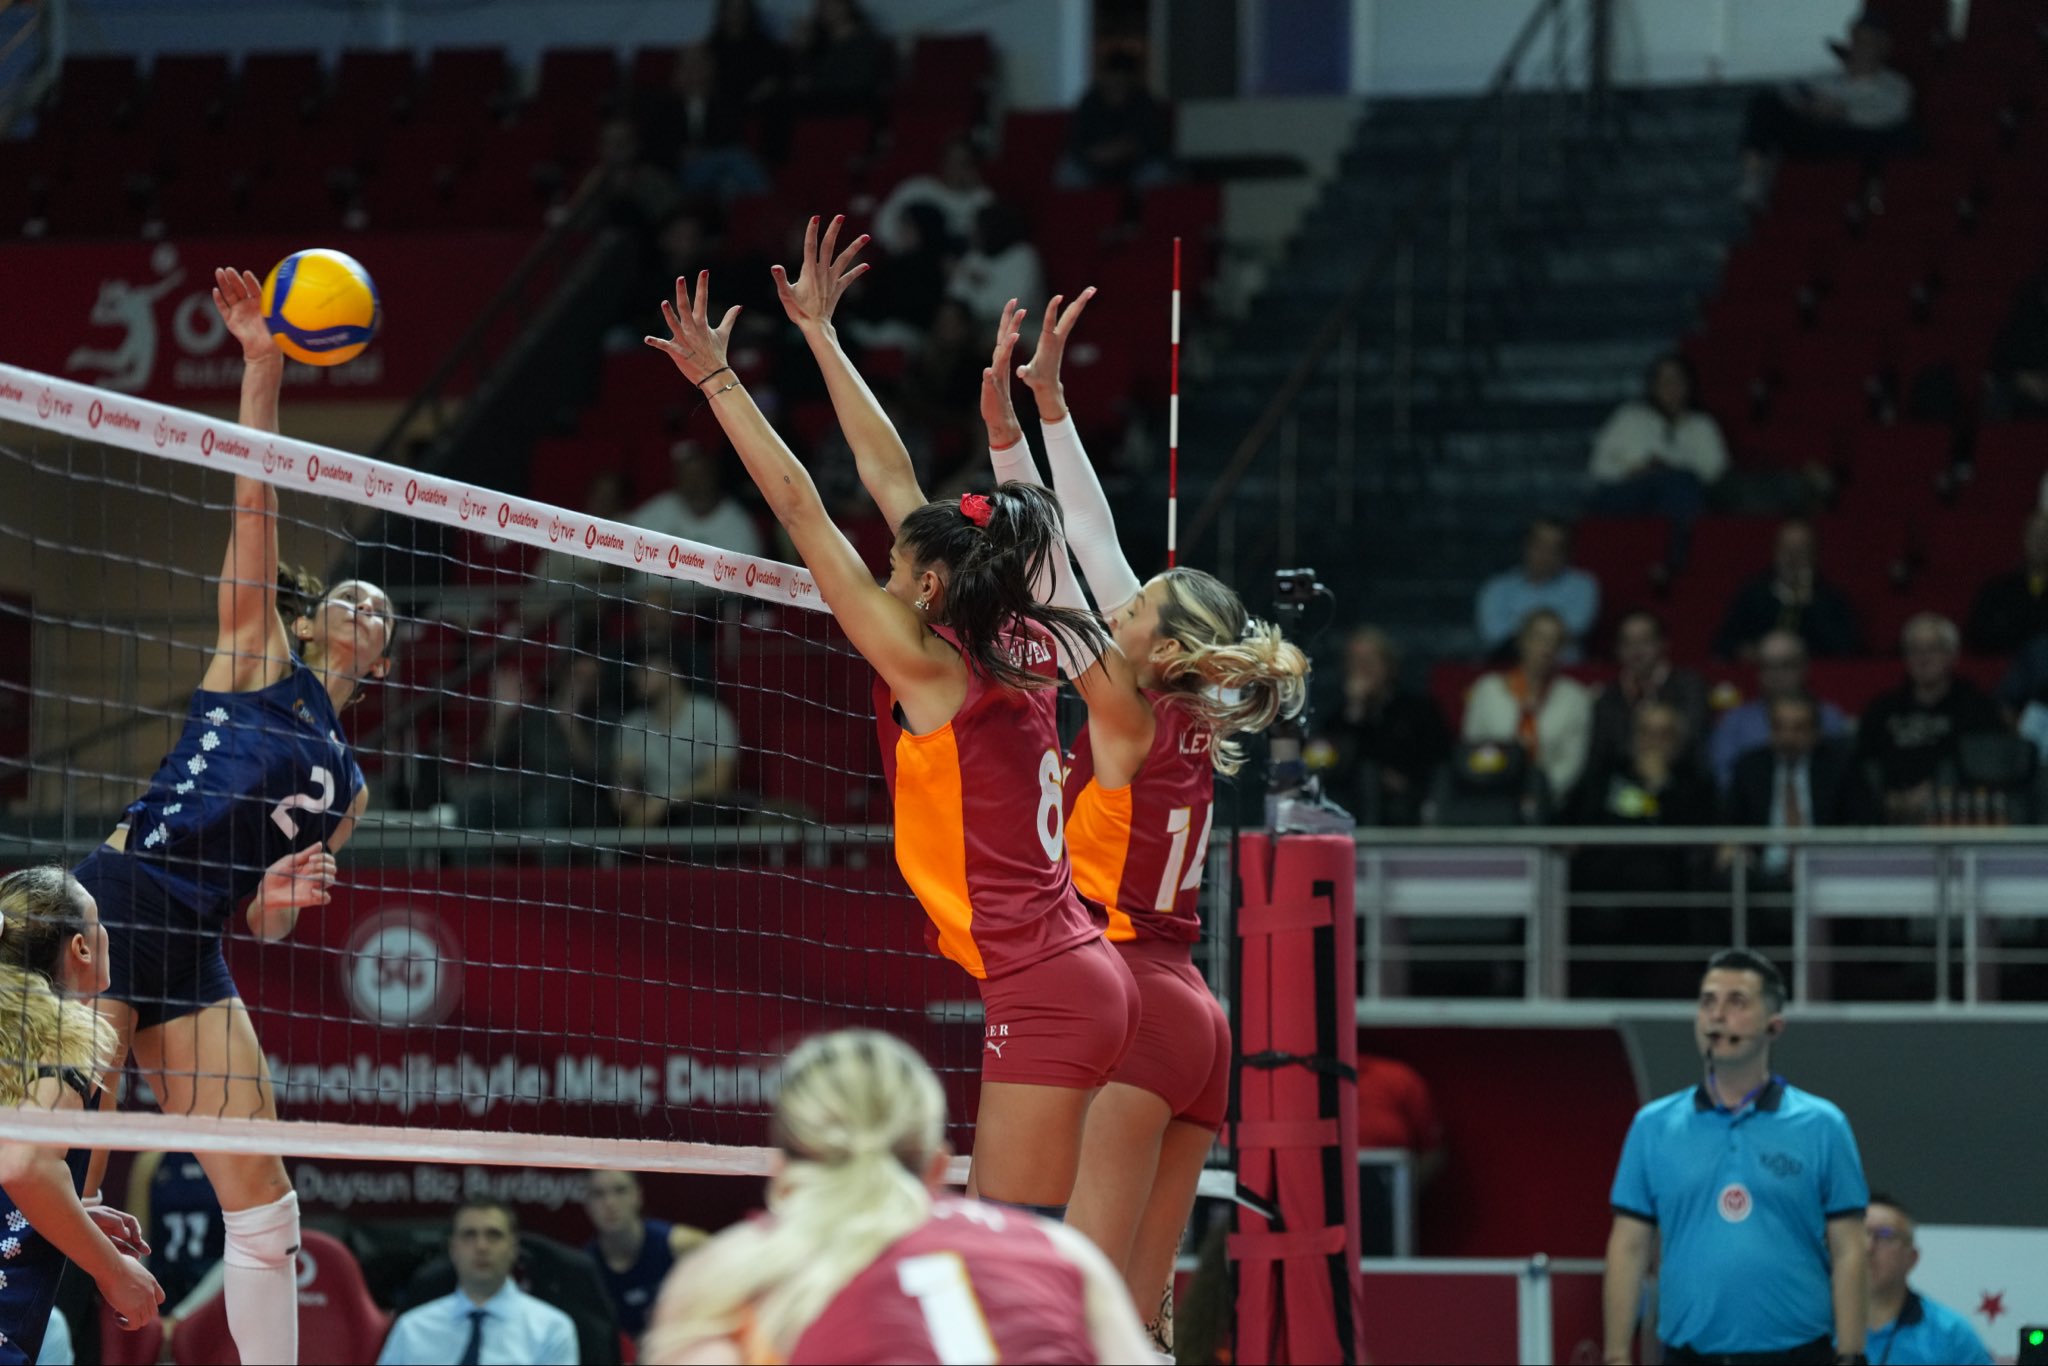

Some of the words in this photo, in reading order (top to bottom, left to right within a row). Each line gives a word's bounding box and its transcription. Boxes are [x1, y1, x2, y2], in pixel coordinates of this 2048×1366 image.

[104, 411, 140, 432] vodafone
[215, 440, 250, 459] vodafone
[277, 456, 294, 471] TVF
[320, 466, 352, 483] vodafone
[377, 479, 393, 495] TVF
[417, 489, 448, 507] vodafone
[472, 503, 487, 518] TVF
[509, 512, 539, 529] vodafone
[560, 526, 575, 541] TVF
[596, 533, 624, 550] vodafone
[645, 546, 659, 560] TVF
[679, 553, 705, 569] vodafone
[724, 565, 737, 580] TVF
[756, 571, 781, 587] vodafone
[800, 582, 812, 596] TVF
[269, 765, 335, 841] 2
[896, 1251, 1001, 1365] 1
